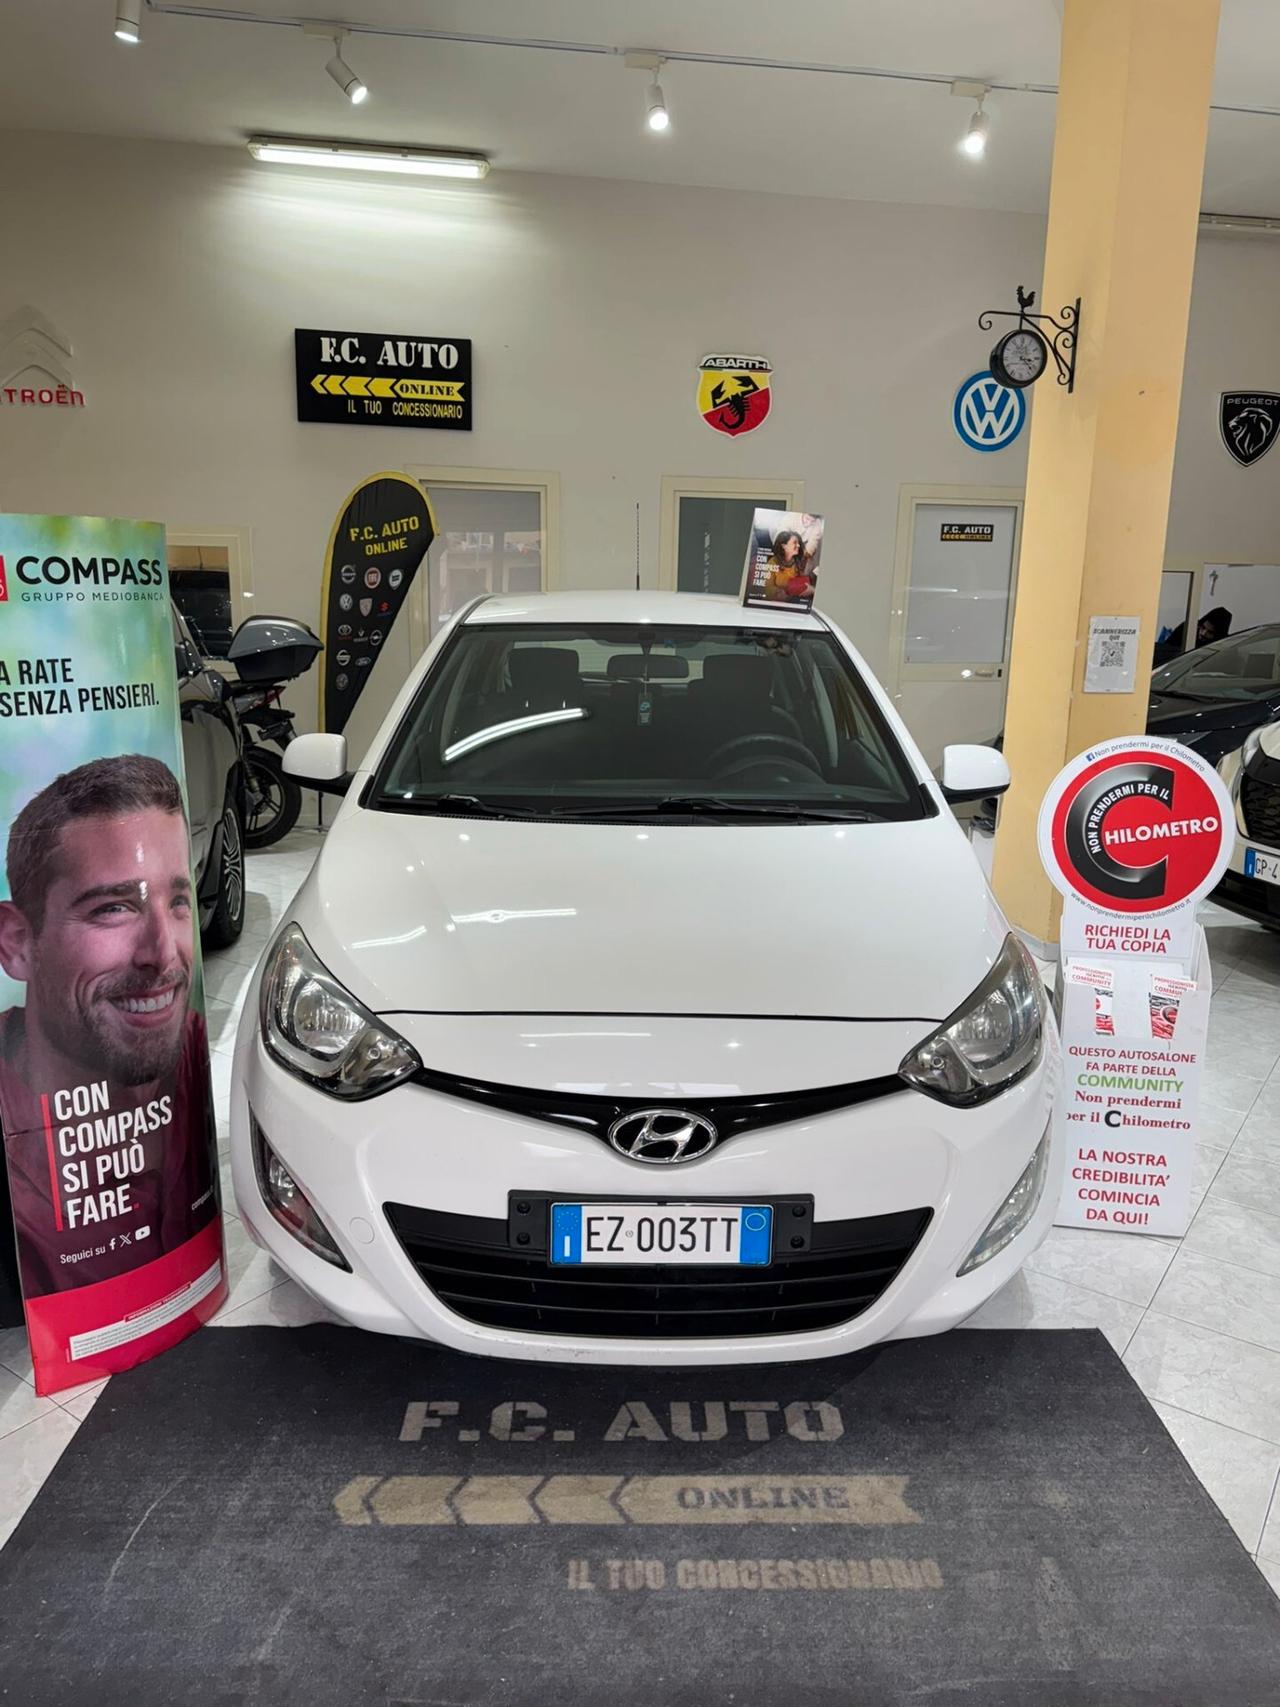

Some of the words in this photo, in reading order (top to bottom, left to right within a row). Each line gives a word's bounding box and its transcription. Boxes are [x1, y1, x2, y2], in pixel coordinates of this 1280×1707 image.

[320, 337, 366, 364] F.C.
[377, 340, 459, 369] AUTO
[705, 358, 767, 369] ABARTH
[400, 383, 455, 396] ONLINE
[348, 400, 356, 413] IL
[364, 400, 382, 414] TUO
[392, 403, 463, 419] CONCESSIONARIO
[1226, 397, 1279, 406] PEUGEOT
[350, 526, 378, 542] F.C.
[382, 516, 419, 537] AUTO
[943, 525, 961, 534] F.C.
[964, 526, 991, 534] AUTO
[365, 537, 408, 556] ONLINE
[16, 555, 163, 586] COMPASS
[22, 592, 86, 602] GRUPPO
[92, 592, 164, 601] MEDIOBANCA
[18, 658, 74, 685] RATE
[0, 690, 72, 717] SENZA
[78, 683, 160, 712] PENSIERI.
[1095, 747, 1110, 757] Non
[1111, 741, 1149, 752] prendermi
[1151, 742, 1162, 750] per
[1170, 746, 1205, 772] Chilometro
[1138, 783, 1158, 796] PER
[1160, 788, 1170, 800] IL
[1088, 784, 1134, 828] PRENDERMI
[1087, 832, 1102, 855] NON
[1085, 924, 1149, 939] RICHIEDI
[1153, 928, 1171, 941] LA
[1086, 938, 1116, 950] TUA
[1121, 939, 1167, 953] COPIA
[1072, 974, 1111, 986] COMMUNITY
[1069, 1046, 1116, 1058] QUESTO
[1119, 1050, 1196, 1063] AUTOSALONE
[1086, 1062, 1099, 1071] FA
[1103, 1063, 1138, 1074] PARTE
[1142, 1066, 1176, 1076] DELLA
[1077, 1073, 1184, 1092] COMMUNITY
[54, 1080, 110, 1120] CON
[1075, 1090, 1103, 1103] Non
[1107, 1096, 1181, 1109] prendermi
[58, 1095, 172, 1157] COMPASS
[1091, 1112, 1100, 1123] il
[1104, 1110, 1191, 1130] Chilometro
[62, 1160, 89, 1193] SI
[96, 1138, 145, 1185] PUÒ
[1078, 1148, 1097, 1161] LA
[1102, 1150, 1167, 1167] NOSTRA
[1078, 1188, 1160, 1206] COMINCIA
[1086, 1208, 1108, 1221] DA
[1113, 1211, 1149, 1225] QUI!
[60, 1249, 93, 1264] Seguici
[95, 1246, 106, 1255] su
[399, 1401, 575, 1442] F.C.
[604, 1401, 845, 1442] AUTO
[676, 1486, 850, 1510] ONLINE
[567, 1559, 596, 1589] IL
[606, 1559, 665, 1590] TUO
[676, 1559, 944, 1590] CONCESSIONARIO
